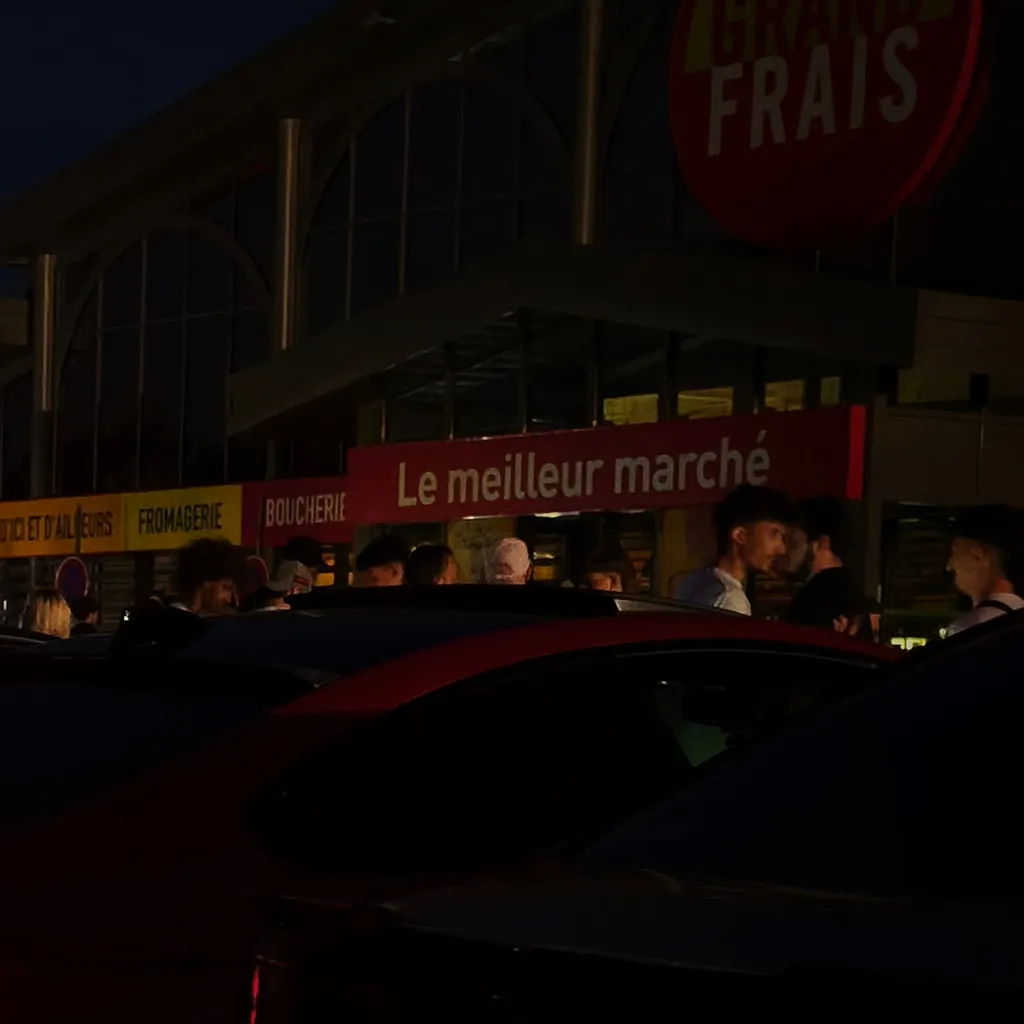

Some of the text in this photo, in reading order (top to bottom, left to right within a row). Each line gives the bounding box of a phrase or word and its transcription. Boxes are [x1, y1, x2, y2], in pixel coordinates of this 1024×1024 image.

[706, 24, 920, 157] FRAIS
[397, 430, 771, 507] Le meilleur marché
[27, 515, 42, 539] ET
[44, 510, 113, 540] D'AILEURS
[138, 502, 223, 534] FROMAGERIE
[265, 492, 347, 527] BOUCHERIE
